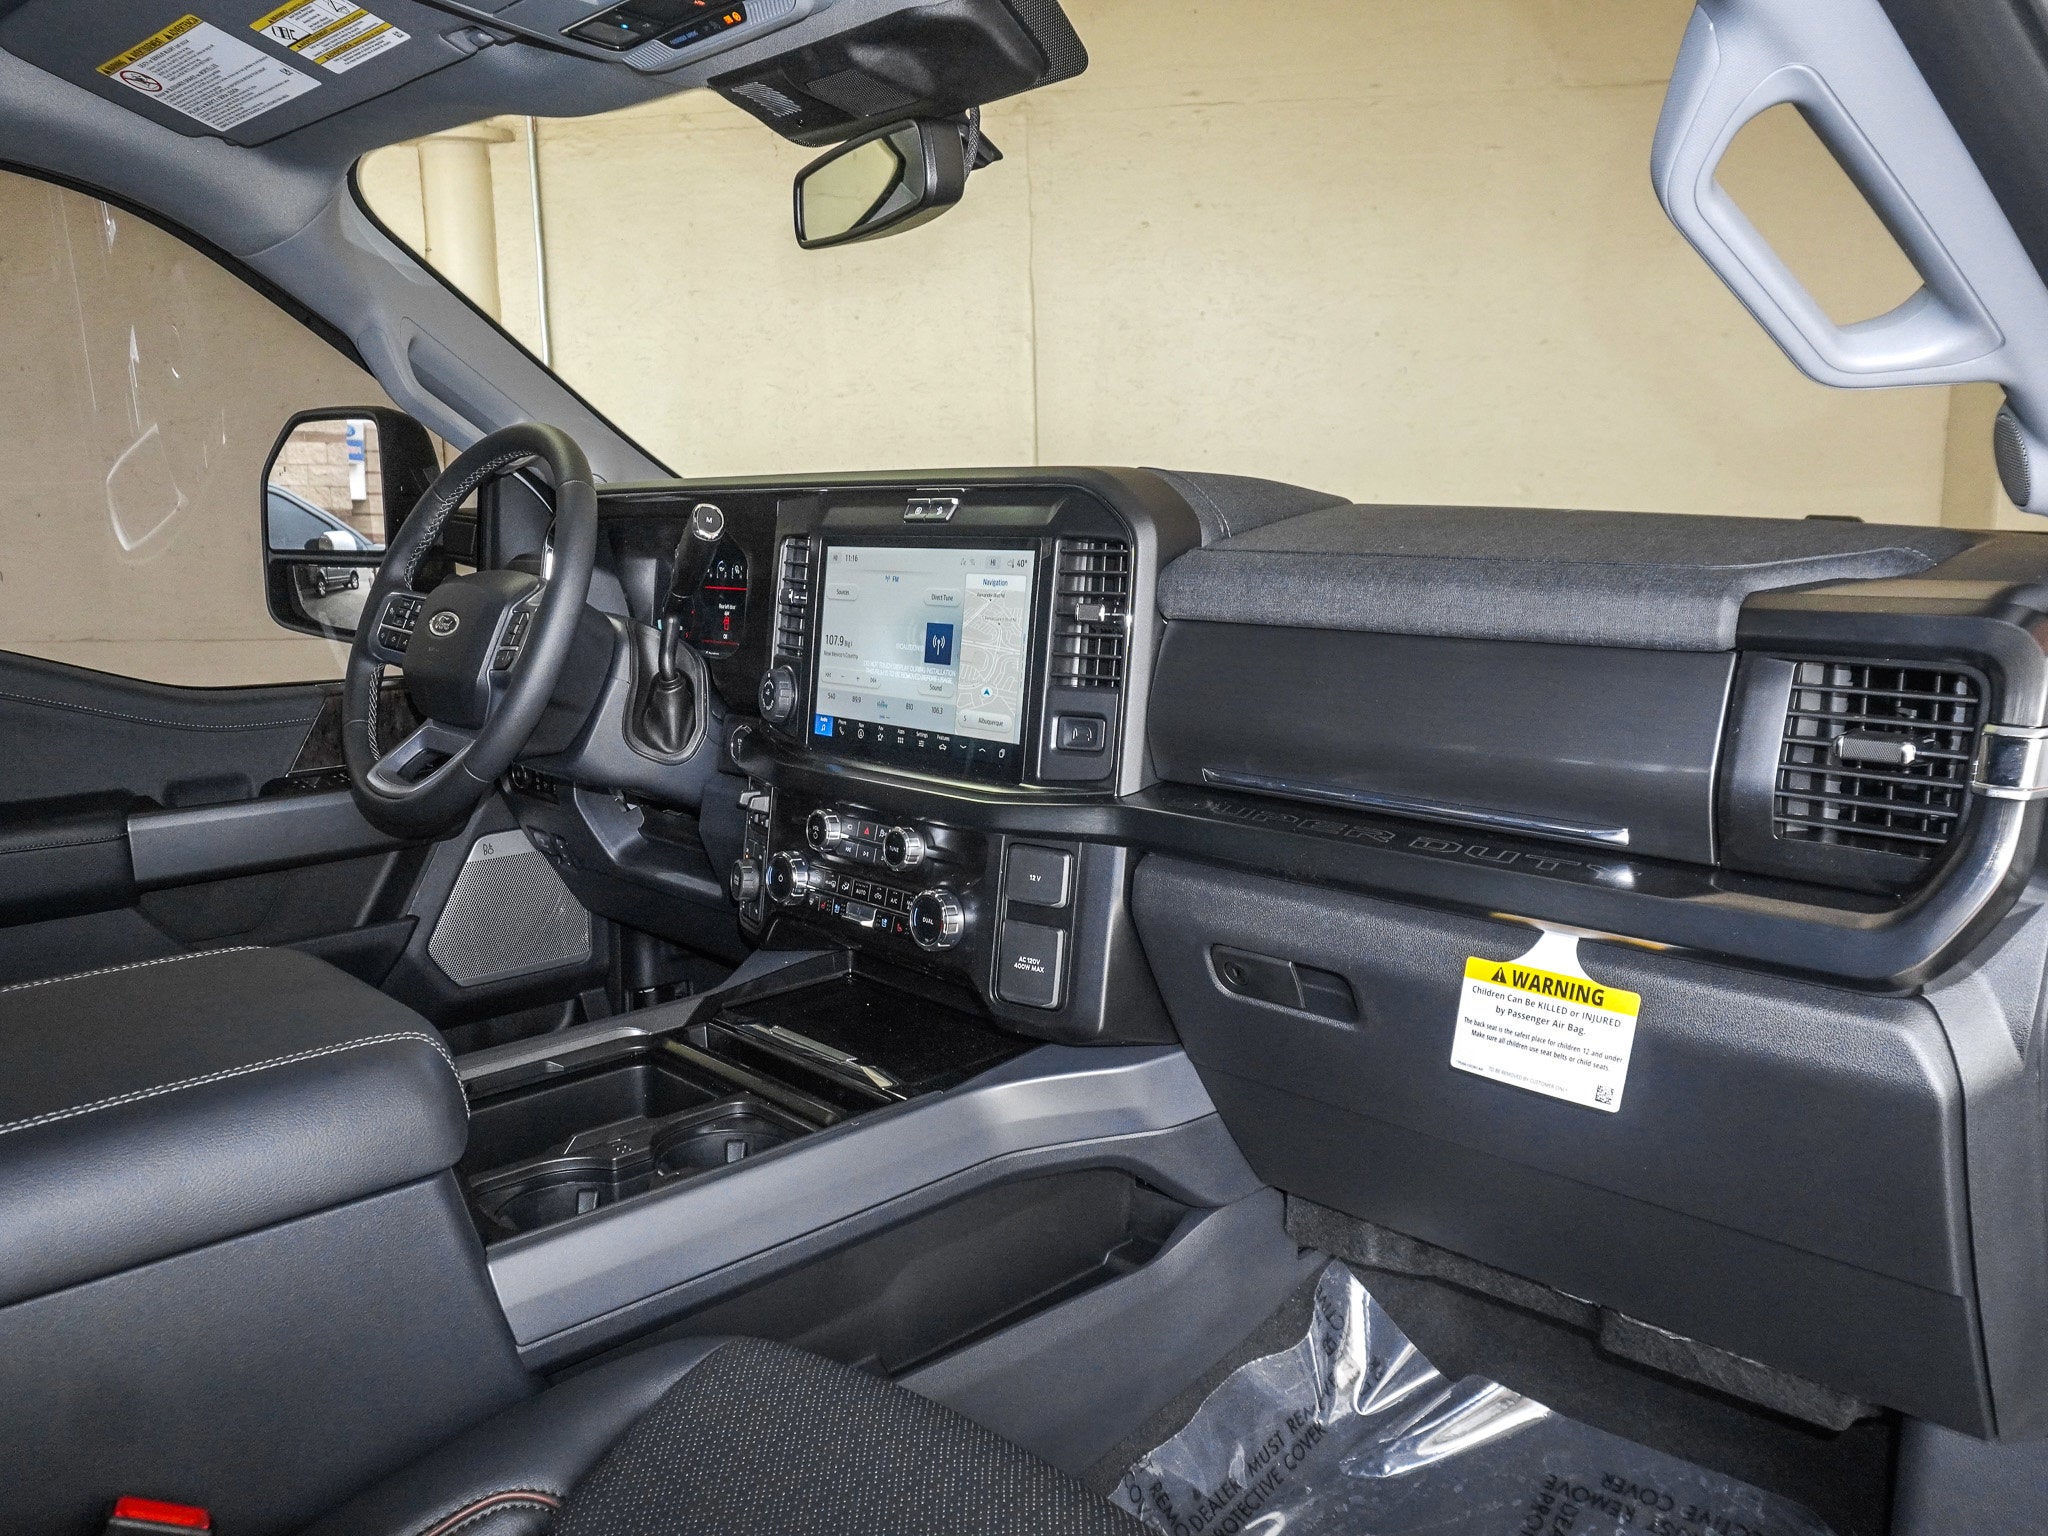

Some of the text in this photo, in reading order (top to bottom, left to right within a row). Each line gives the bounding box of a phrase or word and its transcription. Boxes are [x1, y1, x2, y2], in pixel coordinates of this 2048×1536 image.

[706, 516, 713, 524] M
[982, 578, 1009, 588] Navigation
[825, 634, 844, 647] 107.9
[929, 684, 943, 692] Sound
[1175, 798, 1397, 844] UPER
[1014, 962, 1045, 974] 400W MAX
[1026, 957, 1041, 965] 120V
[1510, 969, 1605, 1006] WARNING
[1471, 985, 1621, 1029] Children Can Be KILLED or INJURED
[1495, 1005, 1586, 1037] by Passenger Air Bag.
[1464, 1016, 1473, 1024] The
[1473, 1019, 1485, 1028] back
[1486, 1023, 1497, 1031] seat
[1514, 1030, 1530, 1040] safest
[1531, 1034, 1546, 1044] place
[1547, 1038, 1556, 1046] for
[1557, 1041, 1581, 1052] children
[1582, 1047, 1589, 1055] 12
[1590, 1049, 1602, 1058] and
[1604, 1053, 1622, 1063] under
[1471, 1029, 1485, 1038] Make
[1486, 1034, 1497, 1042] sure
[1506, 1039, 1528, 1050] children
[1539, 1048, 1551, 1056] seat
[1553, 1051, 1567, 1060] belts
[1576, 1057, 1591, 1067] child
[1188, 1478, 1243, 1532] DEALER
[1247, 1431, 1286, 1478] MUST
[1210, 1463, 1286, 1536] OTECTIVE
[1283, 1423, 1328, 1471] COVER
[1148, 1480, 1191, 1536] REMO
